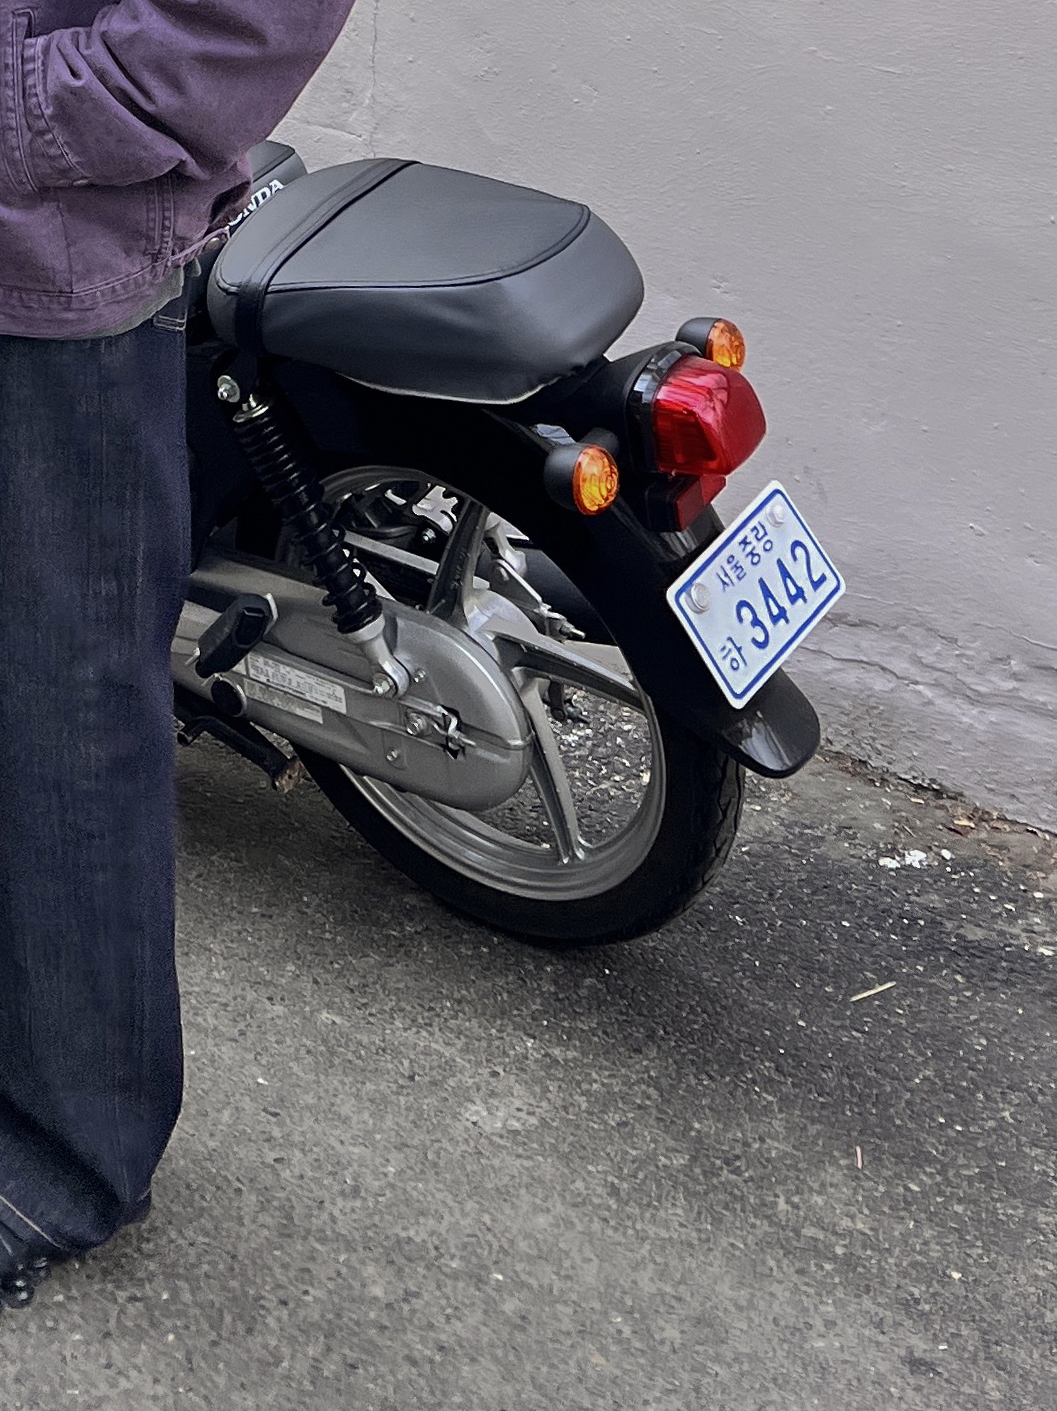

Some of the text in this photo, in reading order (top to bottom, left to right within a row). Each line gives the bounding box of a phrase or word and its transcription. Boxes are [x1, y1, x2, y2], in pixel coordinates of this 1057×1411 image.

[228, 179, 284, 227] NDA
[719, 539, 828, 672] 하 3442
